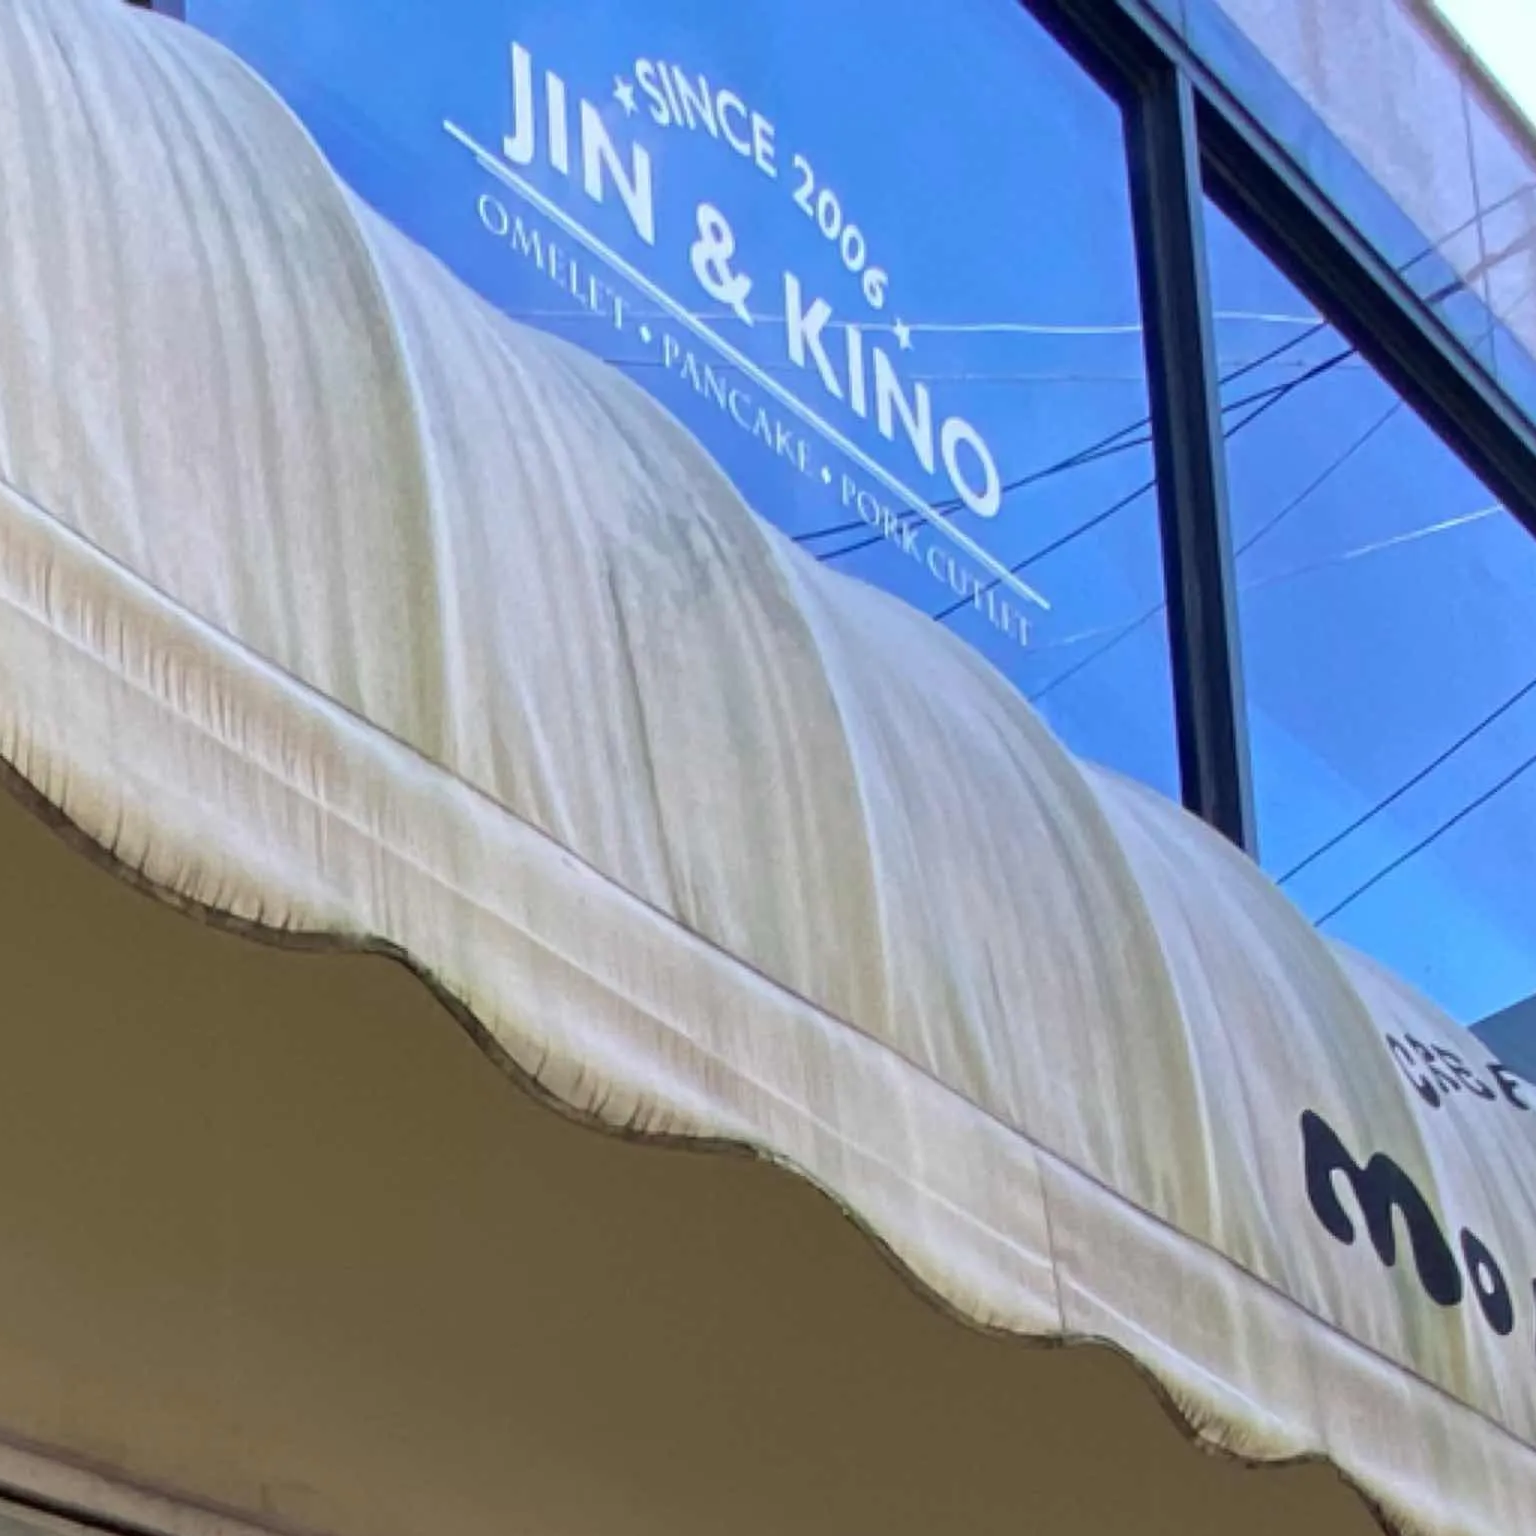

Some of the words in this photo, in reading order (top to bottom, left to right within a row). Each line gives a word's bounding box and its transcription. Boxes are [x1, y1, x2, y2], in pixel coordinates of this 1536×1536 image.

[502, 40, 656, 246] JIN
[690, 203, 754, 327] &
[783, 271, 1003, 519] KINO
[635, 56, 777, 180] SINCE
[794, 155, 889, 311] 2006
[478, 192, 628, 333] OMELET
[662, 331, 816, 481] PANCAKE
[841, 474, 921, 565] PORK
[926, 543, 1035, 649] CUTLET
